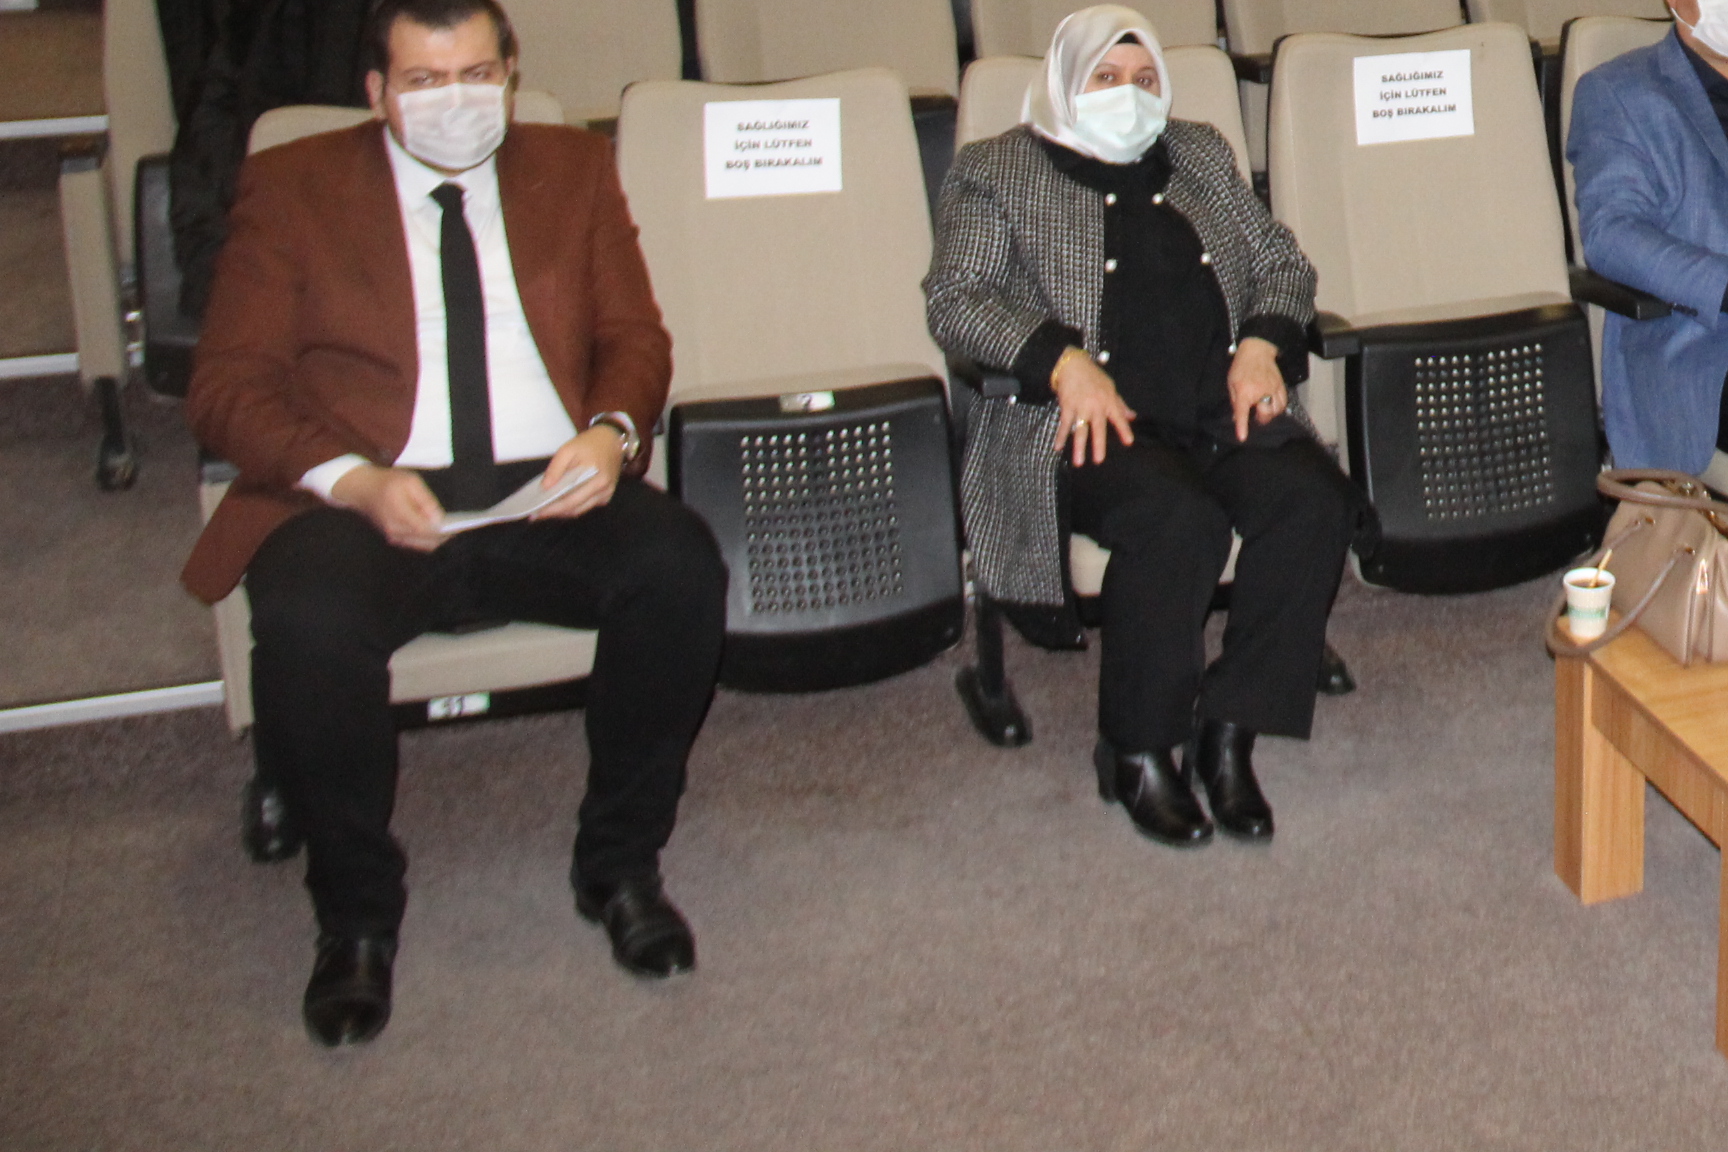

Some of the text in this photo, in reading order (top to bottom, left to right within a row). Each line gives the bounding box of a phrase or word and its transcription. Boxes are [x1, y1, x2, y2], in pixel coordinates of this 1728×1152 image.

[1381, 69, 1443, 83] SAĞLIĞIMIZ
[1380, 86, 1447, 101] İÇİN LÜTFEN
[1372, 103, 1457, 119] BOŞ BIRAKALIM
[736, 118, 810, 132] SAĞLIĞIMIZ
[735, 136, 813, 152] İÇİN LÜTFEN
[725, 156, 823, 172] BOŞ BIRAKALIM
